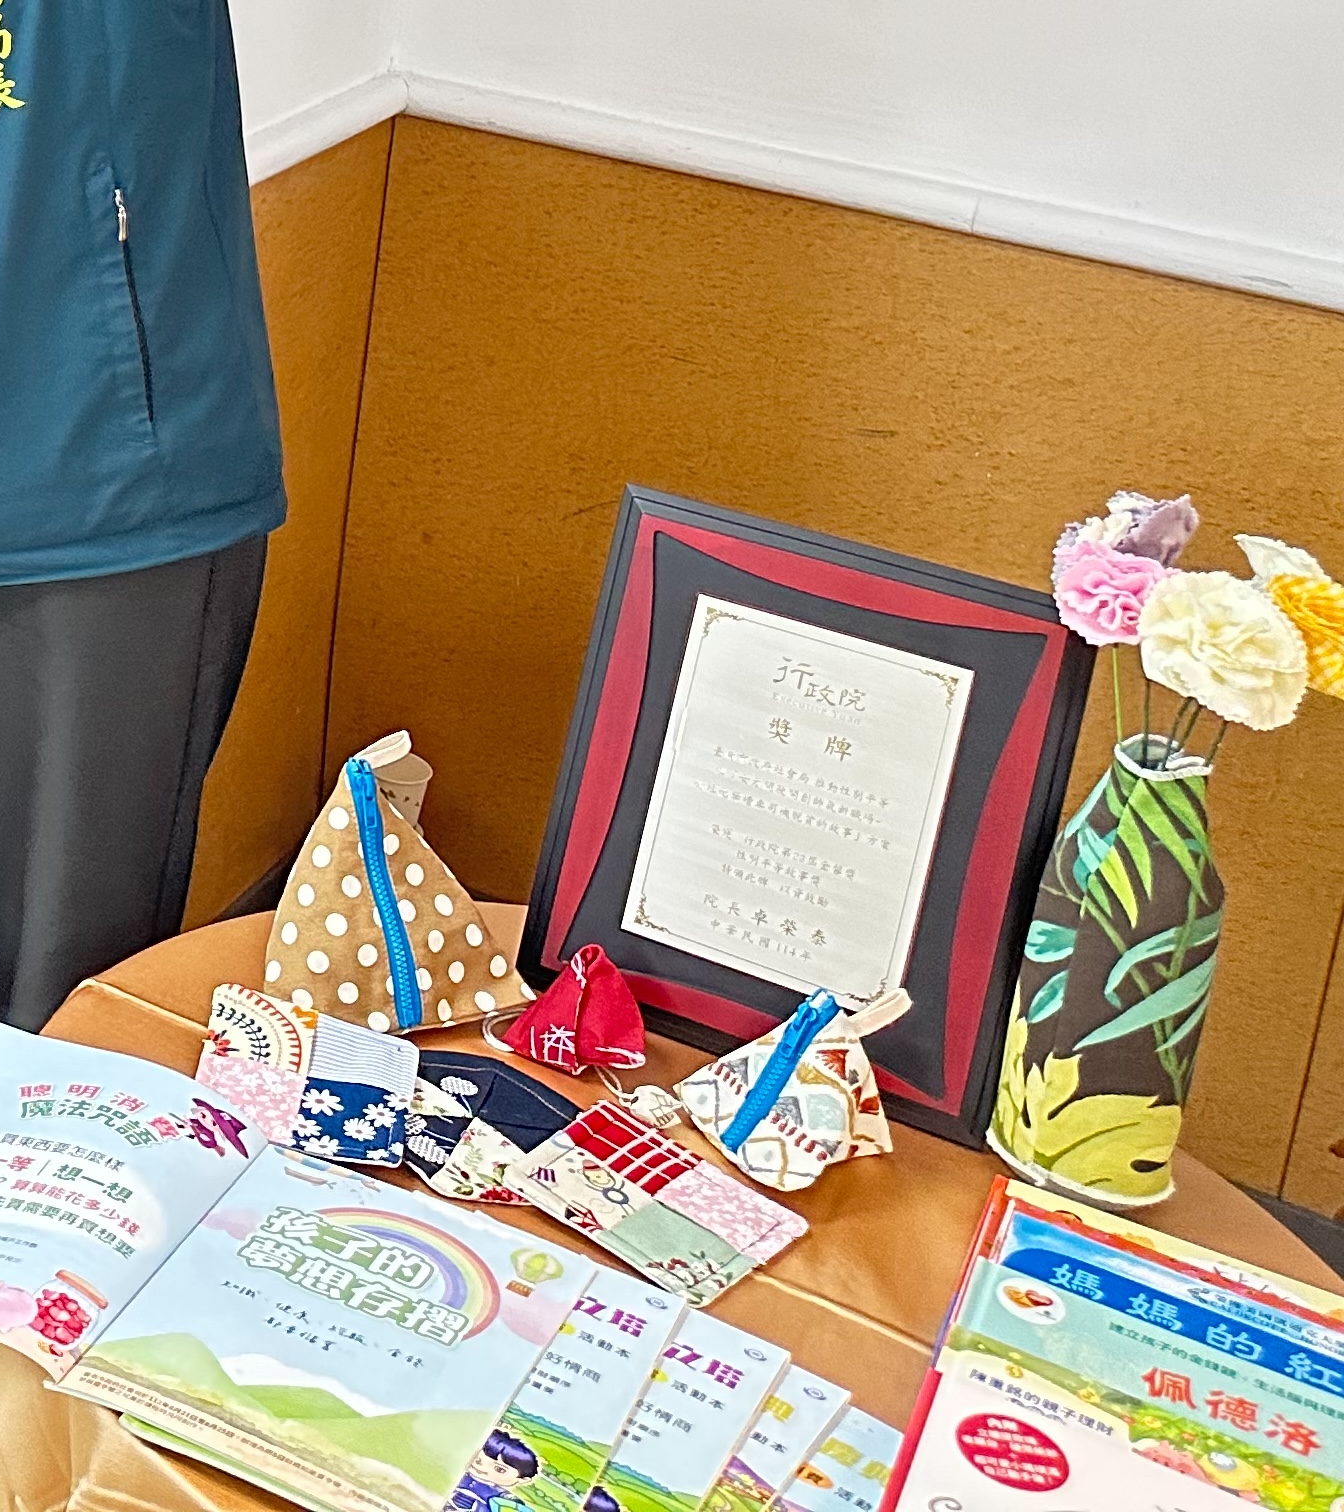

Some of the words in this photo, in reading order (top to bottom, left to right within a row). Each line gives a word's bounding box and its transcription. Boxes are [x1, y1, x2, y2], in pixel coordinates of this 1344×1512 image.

[773, 656, 866, 712] 行政院
[266, 1206, 440, 1289] 孩子的
[239, 1236, 469, 1347] 夢想存摺
[1141, 1366, 1324, 1457] 佩德洛
